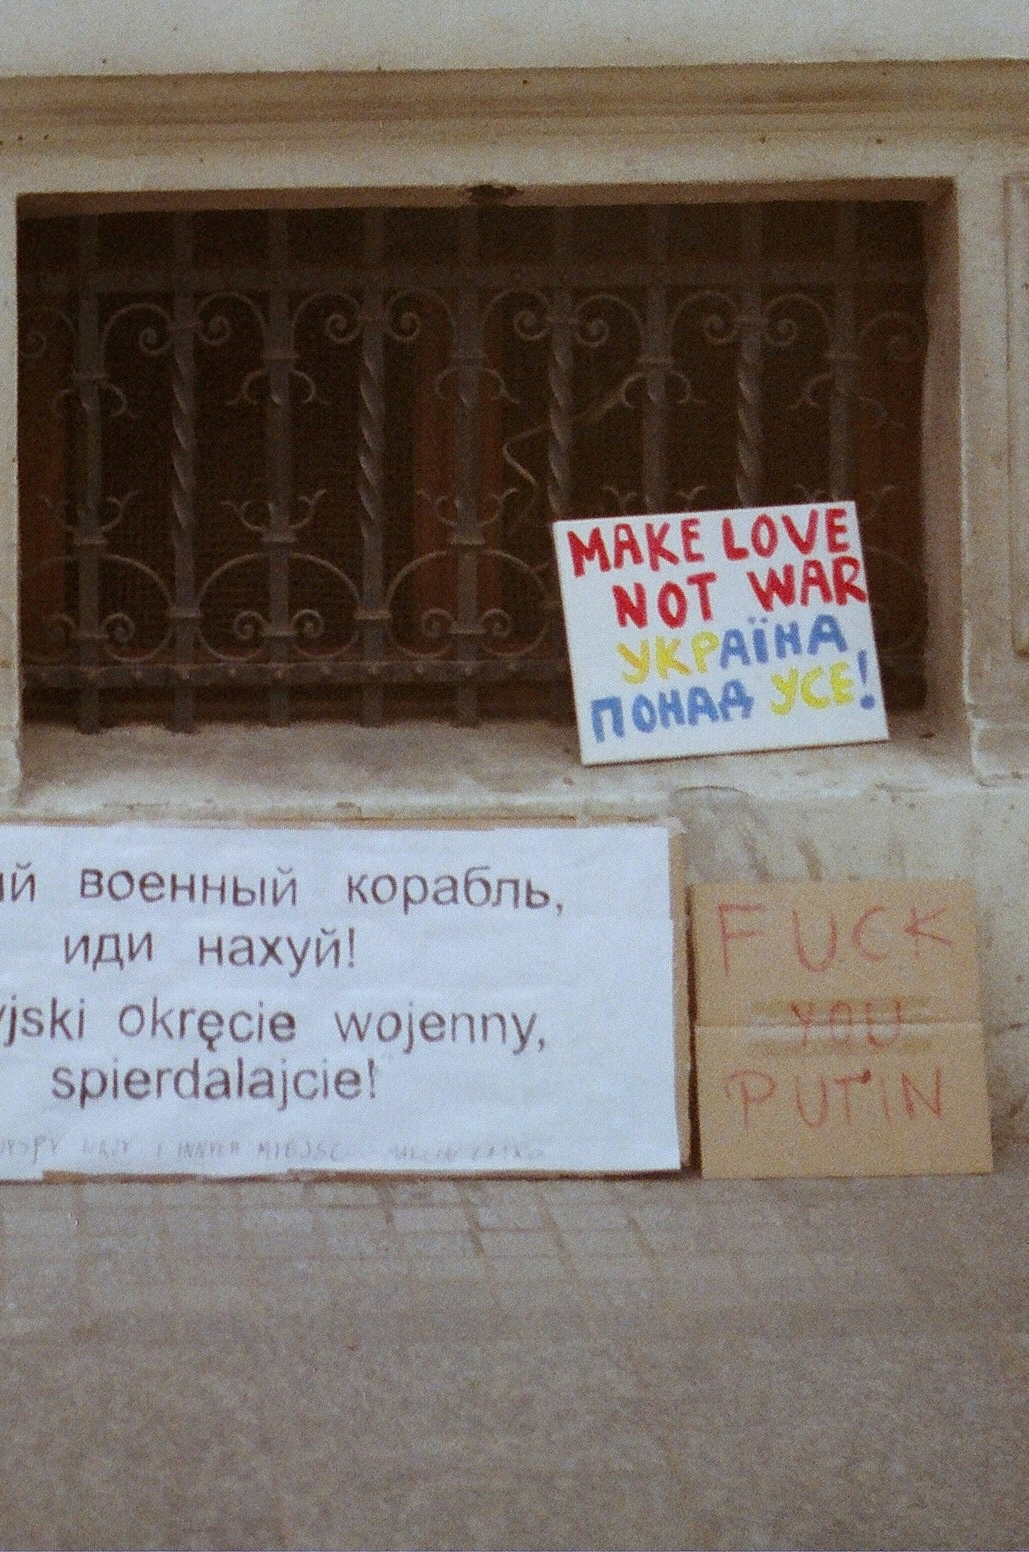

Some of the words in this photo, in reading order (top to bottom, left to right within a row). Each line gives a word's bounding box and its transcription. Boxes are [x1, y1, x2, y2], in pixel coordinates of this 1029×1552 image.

[567, 517, 706, 578] MAKE
[722, 507, 852, 562] LOVE
[612, 571, 718, 630] NOT
[746, 555, 870, 612] WAR
[615, 614, 849, 685] УКРАЇНА
[590, 679, 756, 743] ПОНАД
[770, 649, 877, 716] УСЕ!
[79, 866, 298, 909] военный
[346, 865, 564, 916] корабль,
[63, 931, 154, 971] иди
[197, 926, 356, 979] нахуй!
[716, 902, 953, 977] FUCK
[118, 996, 298, 1053] okręcie
[334, 1001, 547, 1056] wojenny,
[788, 999, 904, 1049] YOU
[51, 1056, 377, 1112] spierdalajcie!
[725, 1065, 943, 1131] PUTIN
